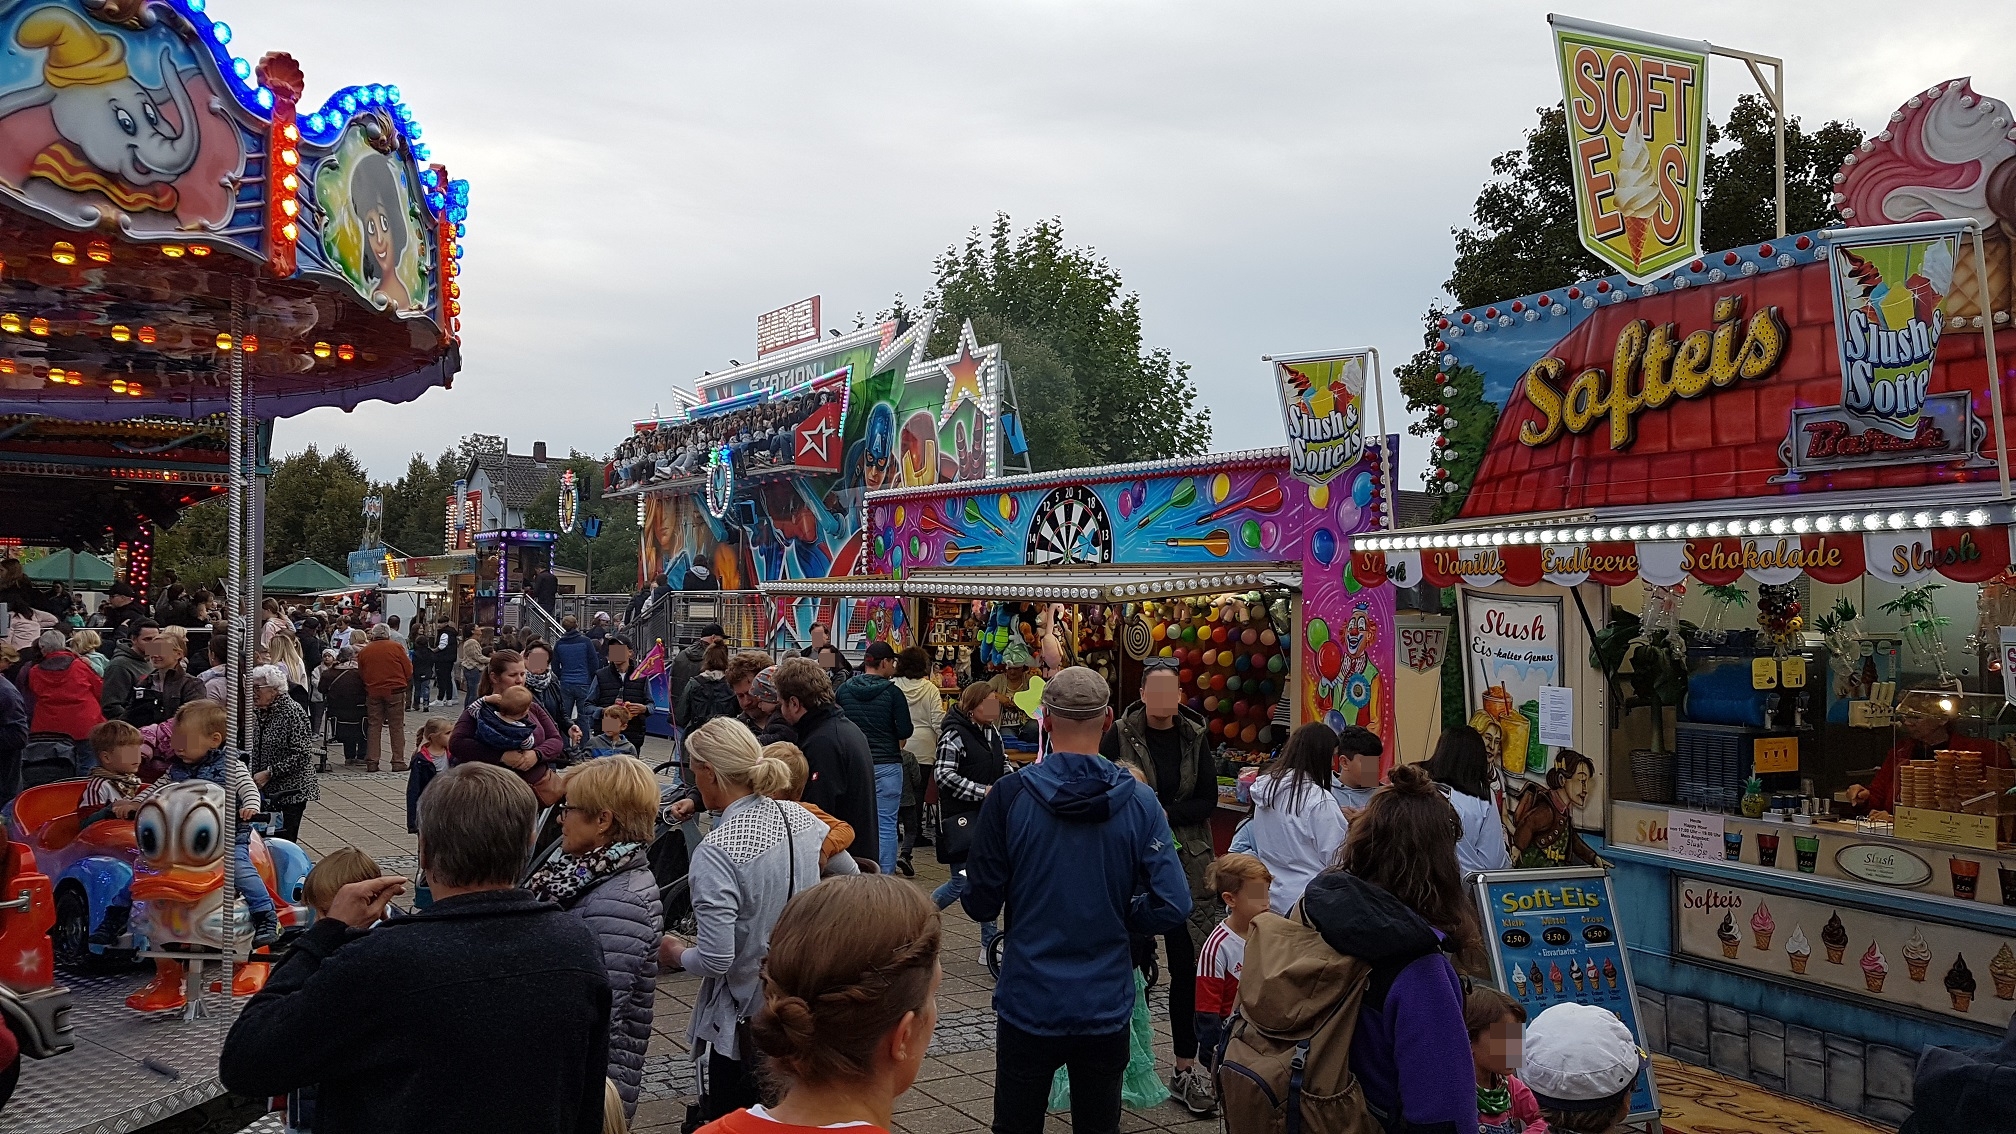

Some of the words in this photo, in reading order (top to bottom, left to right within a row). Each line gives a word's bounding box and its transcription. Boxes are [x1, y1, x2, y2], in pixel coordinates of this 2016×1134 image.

[1573, 46, 1694, 145] SOFT
[1577, 134, 1687, 245] ES
[1845, 309, 1931, 368] Slush
[749, 363, 817, 391] STATION
[1519, 294, 1786, 450] Softeis
[1289, 404, 1346, 443] Slush
[1345, 403, 1358, 428] &
[1293, 430, 1361, 475] Softeis
[1055, 492, 1060, 502] 5
[1065, 487, 1074, 498] 20
[1078, 489, 1082, 500] 1
[1043, 501, 1051, 512] 12
[1087, 497, 1096, 509] 18
[1036, 515, 1041, 525] 9
[1097, 511, 1102, 522] 4
[1029, 533, 1037, 544] 14
[1101, 530, 1109, 541] 13
[1027, 551, 1034, 562] 11
[1103, 549, 1109, 560] 6
[1362, 552, 1406, 582] Slush
[1434, 550, 1507, 576] Vanille
[1541, 547, 1640, 575] Erdbeere
[1680, 538, 1843, 571] Schokolade
[1892, 531, 1981, 577] Slush
[1480, 609, 1546, 641] Slush
[1402, 629, 1443, 647] SOFT
[1408, 647, 1437, 668] ES
[1472, 635, 1492, 657] Eis
[1524, 651, 1554, 664] Genuss
[1636, 819, 1669, 843] Slu
[1864, 852, 1894, 866] Slush
[1501, 887, 1600, 913] Soft-Eis
[1683, 887, 1742, 914] Softeis
[1502, 919, 1525, 928] Klein
